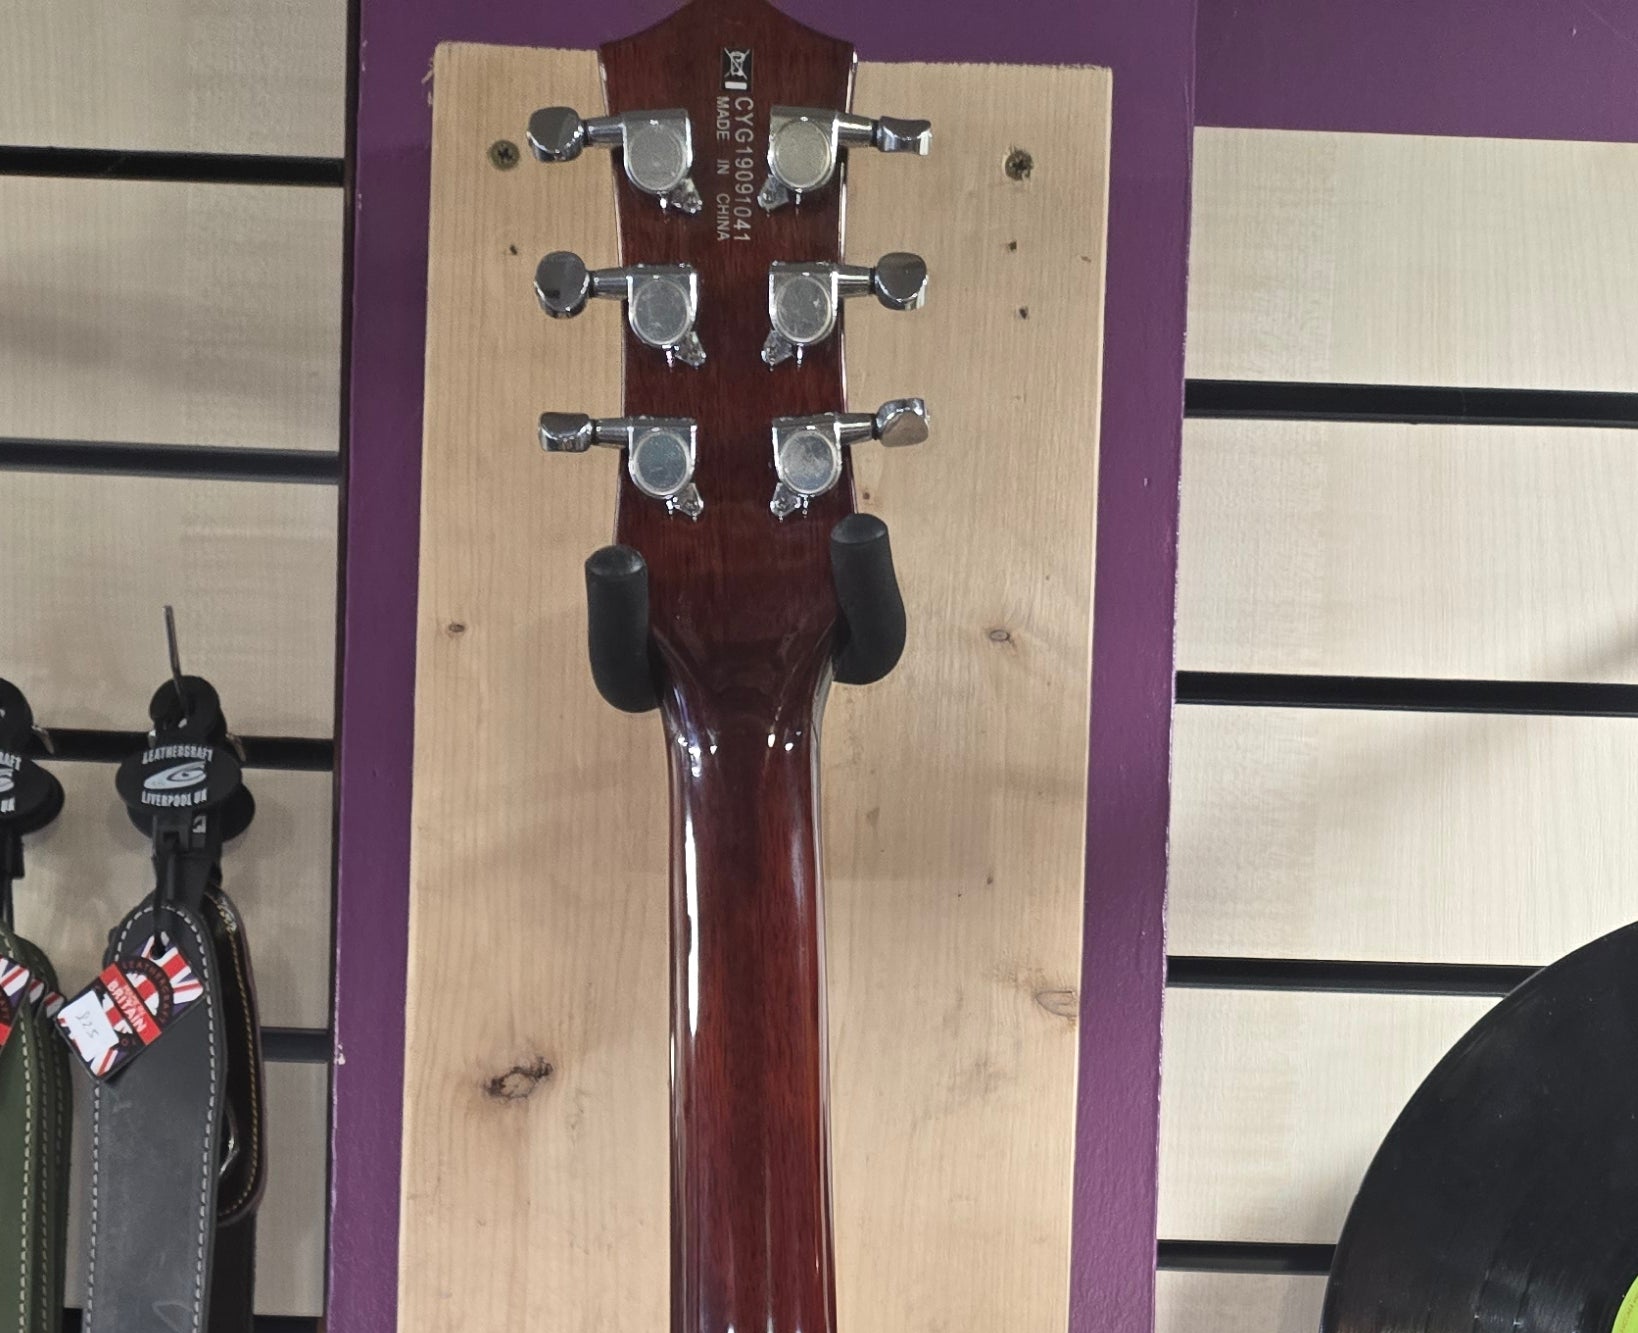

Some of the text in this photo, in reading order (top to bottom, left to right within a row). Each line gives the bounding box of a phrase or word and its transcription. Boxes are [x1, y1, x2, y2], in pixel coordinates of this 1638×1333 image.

[716, 96, 730, 241] MADE IN CHINA
[733, 97, 754, 241] CYG19091041
[141, 788, 207, 807] LIVERPOOL UK
[107, 979, 148, 1033] BRITAIN
